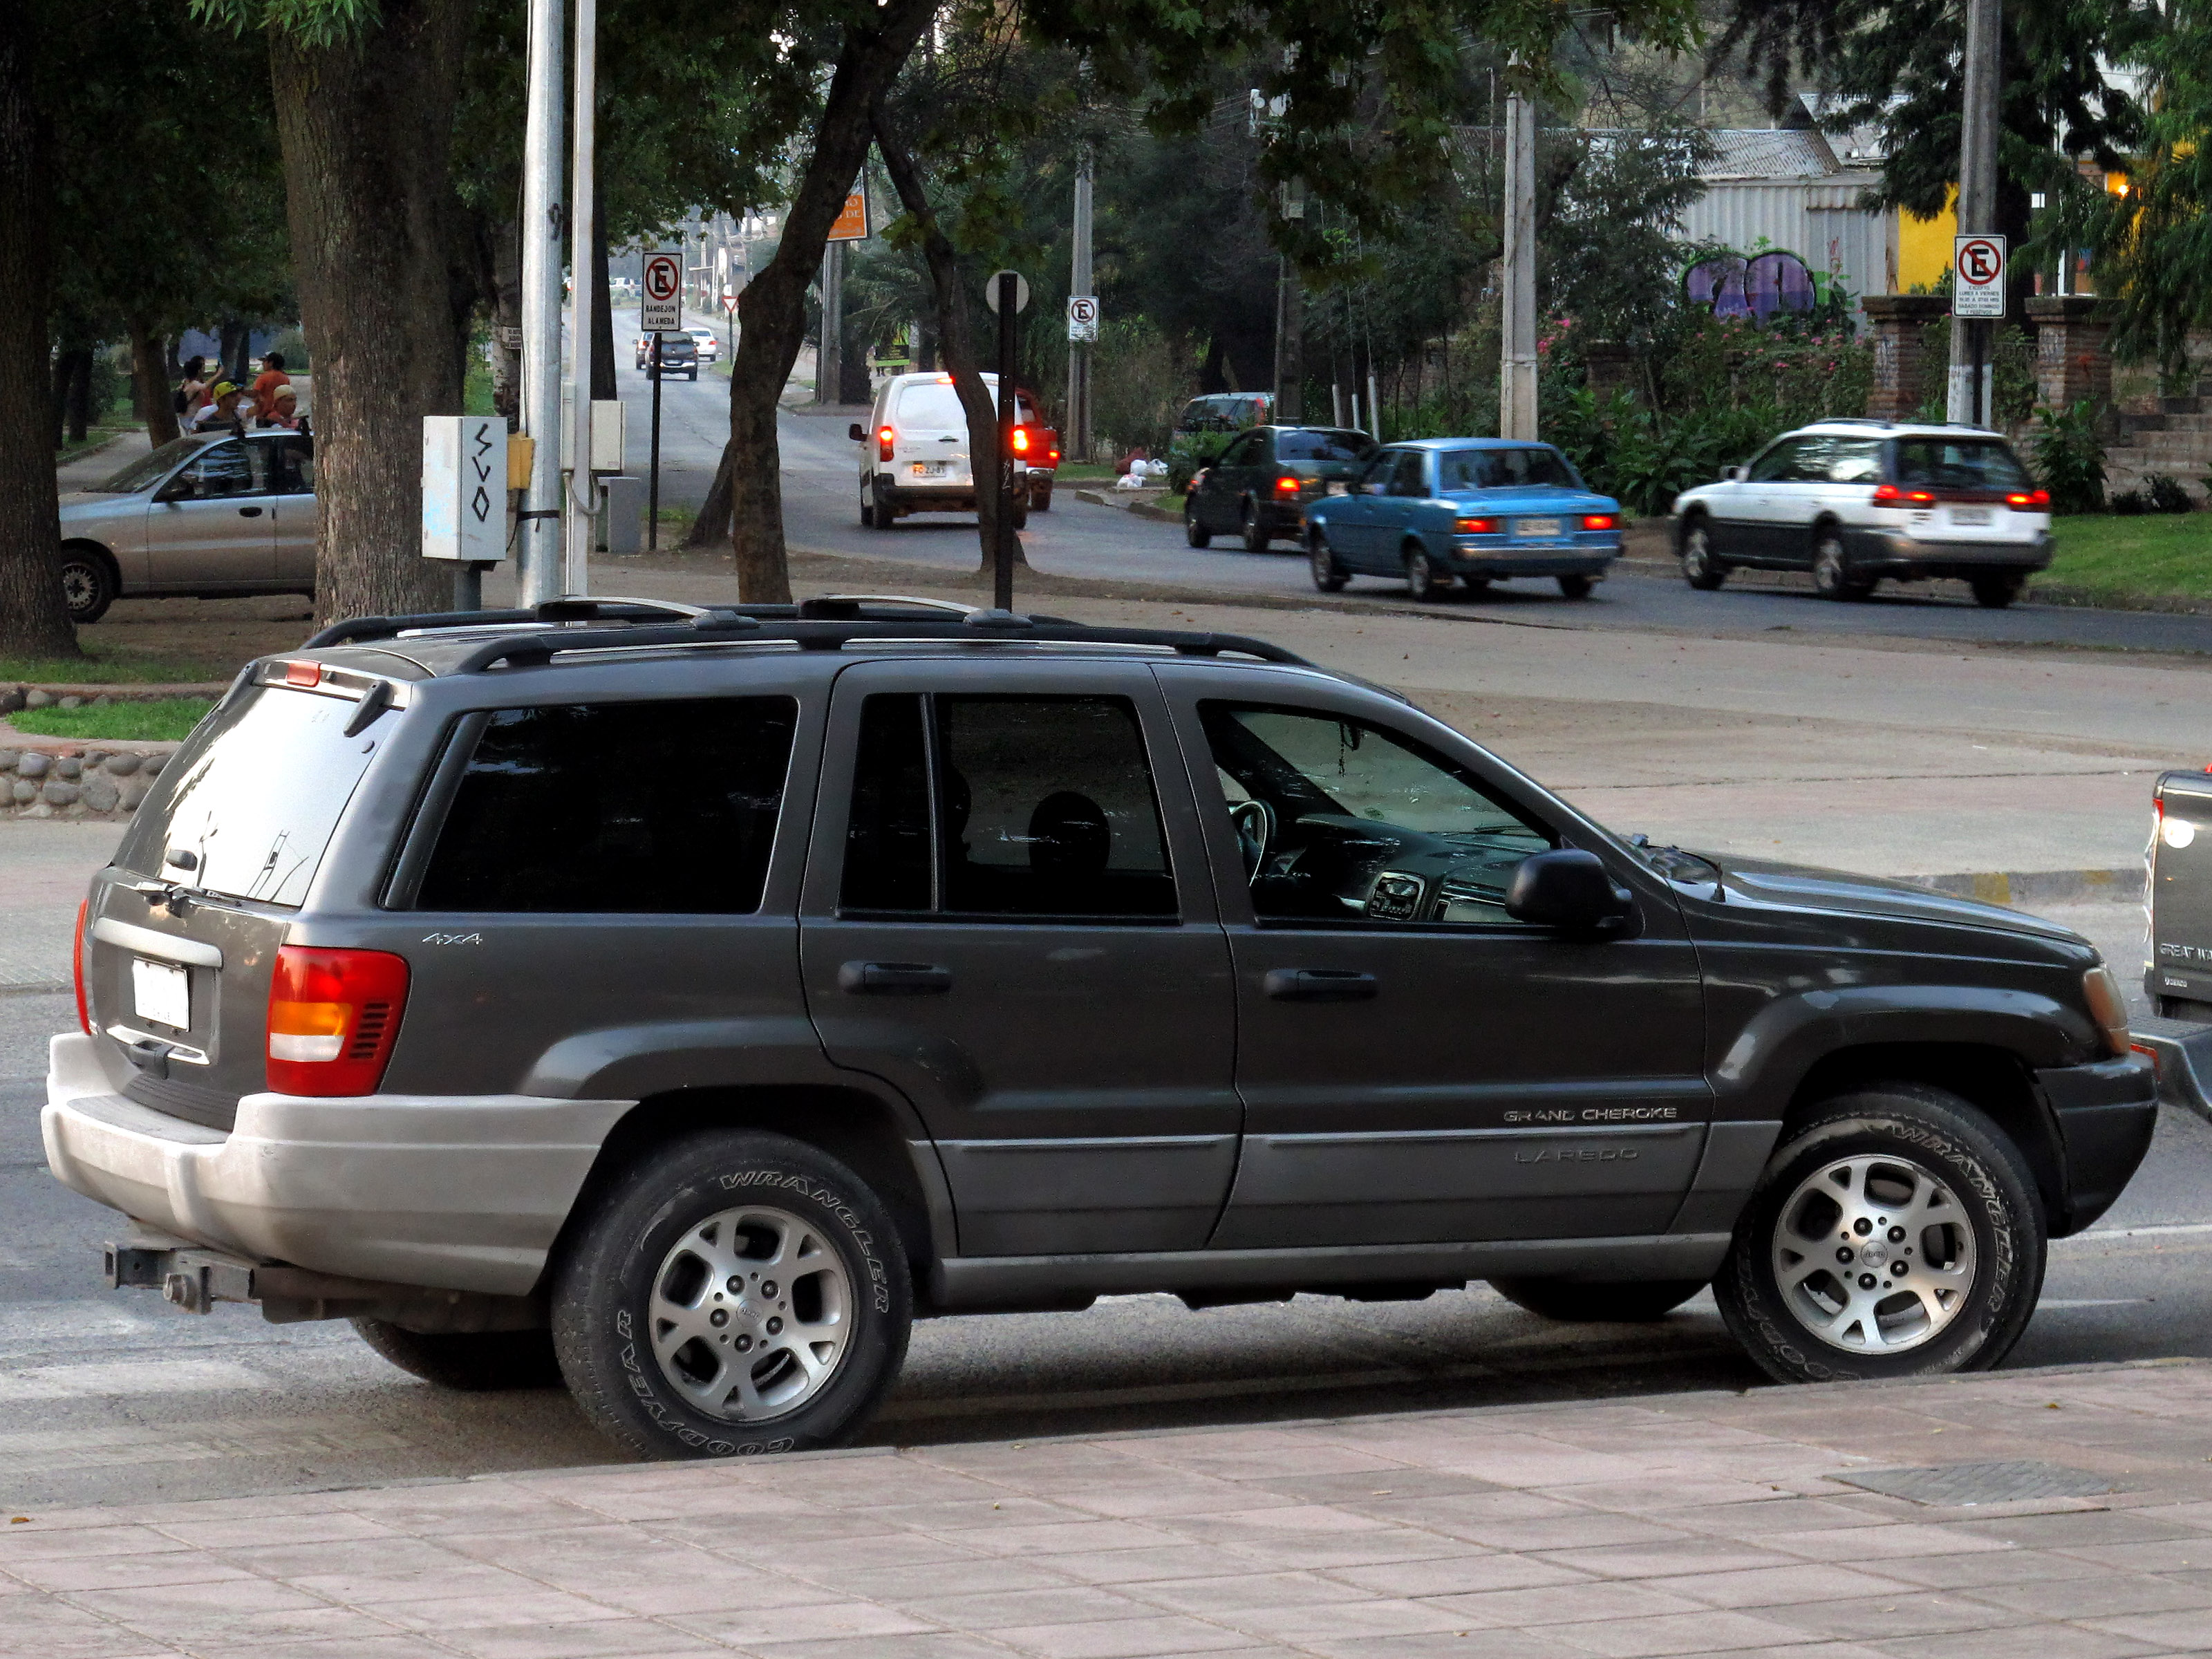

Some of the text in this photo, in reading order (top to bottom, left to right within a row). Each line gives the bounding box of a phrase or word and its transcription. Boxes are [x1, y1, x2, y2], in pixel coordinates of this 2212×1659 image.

[646, 305, 676, 313] BANDEJON
[648, 317, 675, 325] ALAMEDA
[2159, 942, 2195, 958] GREAT
[1503, 1110, 1575, 1122] GRAND
[1515, 1148, 1640, 1163] LAREDO
[718, 1170, 890, 1314] WRANGLER
[617, 1309, 795, 1455] GOODYEAR
